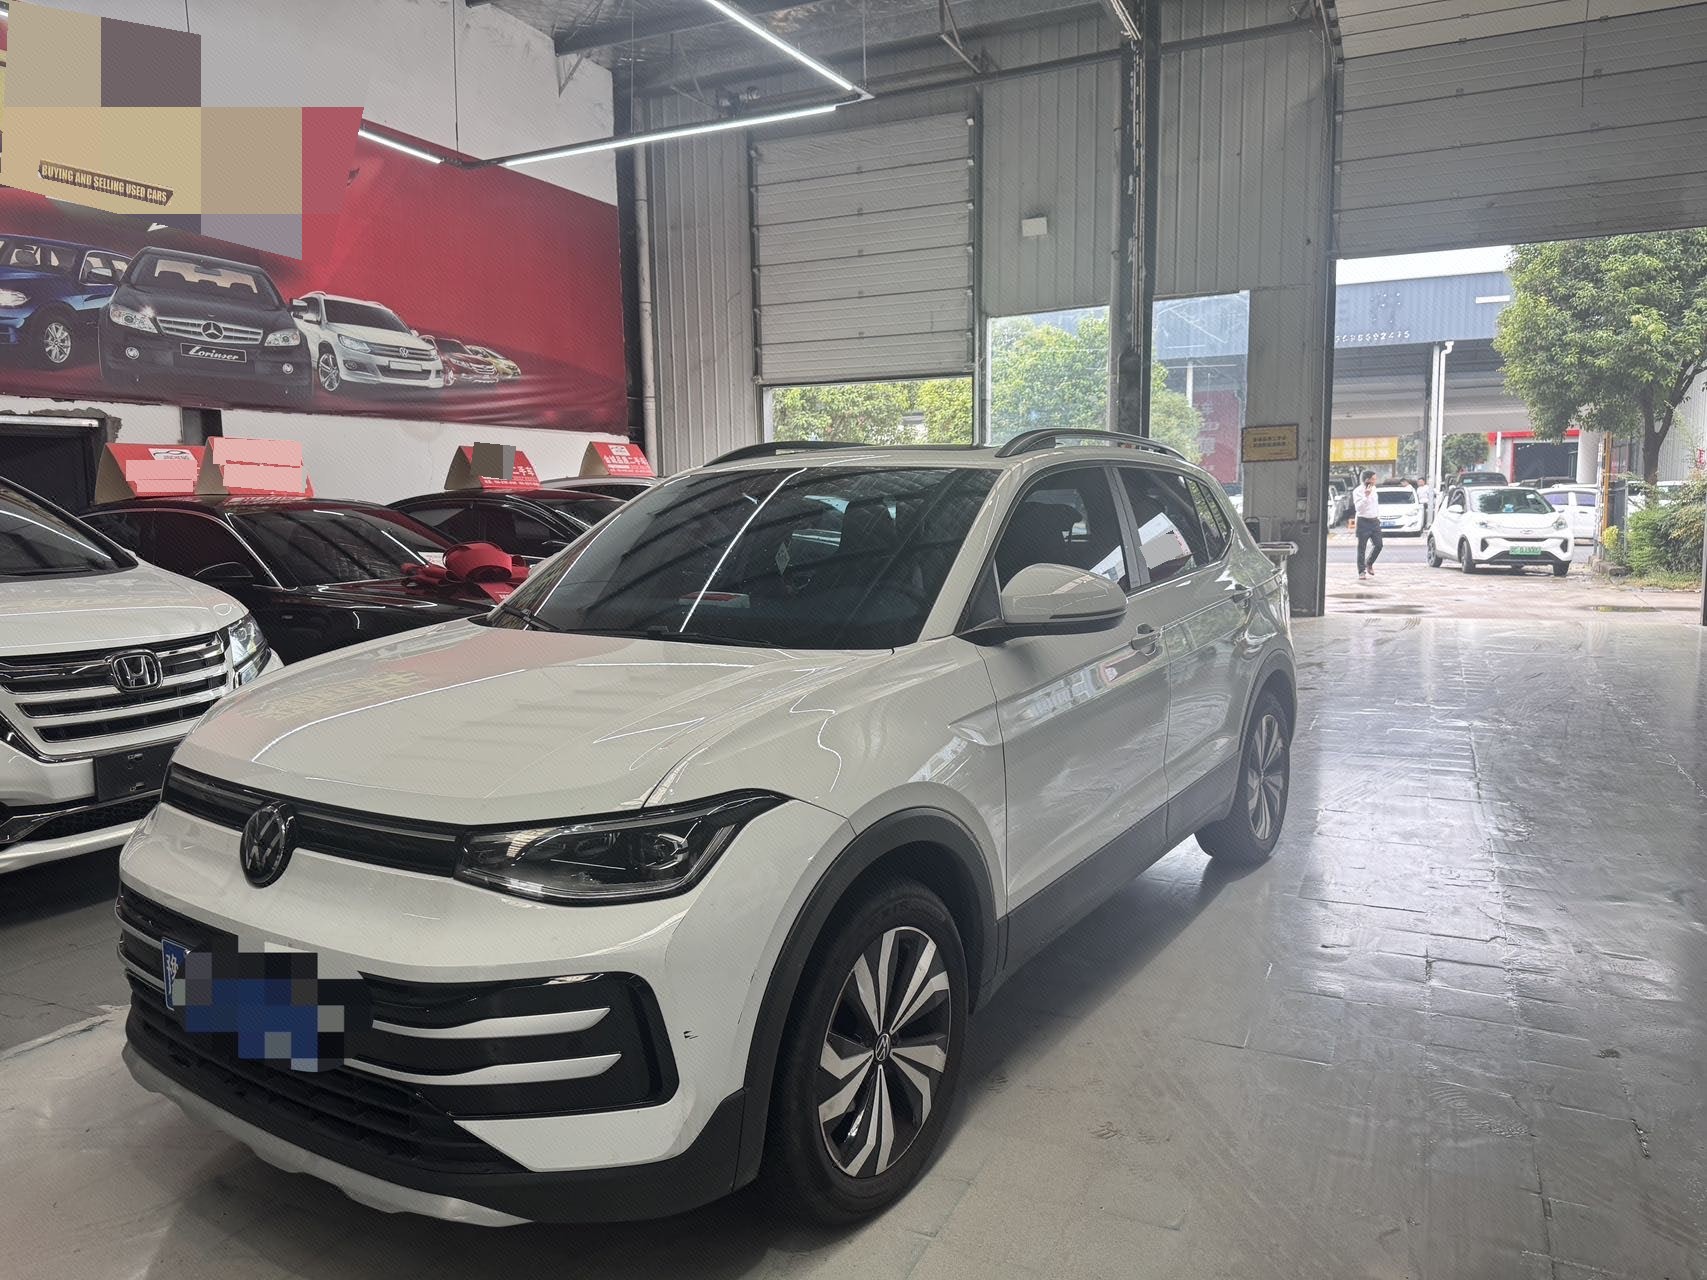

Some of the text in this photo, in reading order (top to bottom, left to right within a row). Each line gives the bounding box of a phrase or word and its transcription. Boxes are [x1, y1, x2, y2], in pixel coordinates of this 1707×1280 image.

[41, 164, 167, 202] BUYING AND SELLING USED CARS
